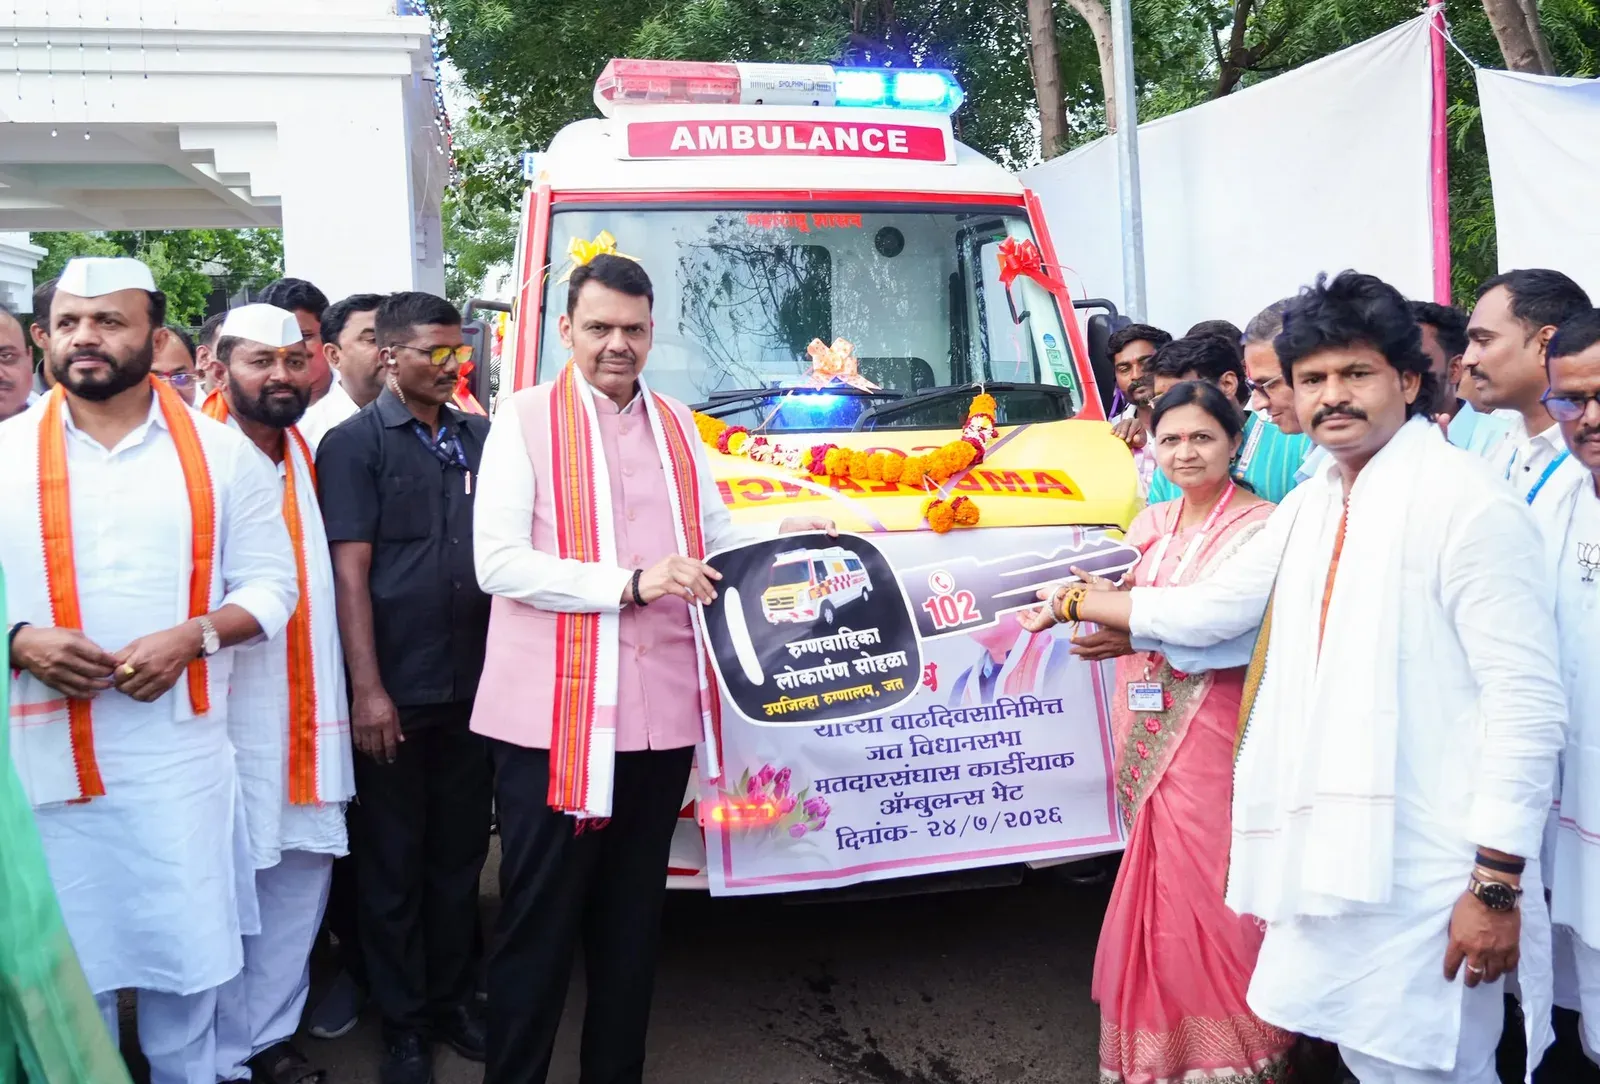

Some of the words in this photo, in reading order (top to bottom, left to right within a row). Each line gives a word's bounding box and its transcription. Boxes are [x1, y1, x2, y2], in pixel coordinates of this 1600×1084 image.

[670, 126, 909, 153] AMBULANCE
[811, 213, 862, 229] शासन
[923, 590, 981, 629] 102
[785, 626, 882, 659] रुग्णवाहिका
[773, 657, 851, 690] लोकार्पण
[852, 650, 908, 676] सोहळा
[762, 694, 819, 717] उपजिल्हा
[821, 683, 881, 706] रुग्णालय,
[880, 677, 905, 692] जत
[891, 697, 1065, 731] वाढदिवसानिमित्त
[865, 743, 903, 761] जत
[909, 730, 1023, 758] विधानसभा
[814, 763, 961, 796] मतदारसंघास
[967, 750, 1076, 778] कार्डीयाक
[991, 780, 1025, 803] भेट
[927, 804, 1064, 839] २४/७/२०२६
